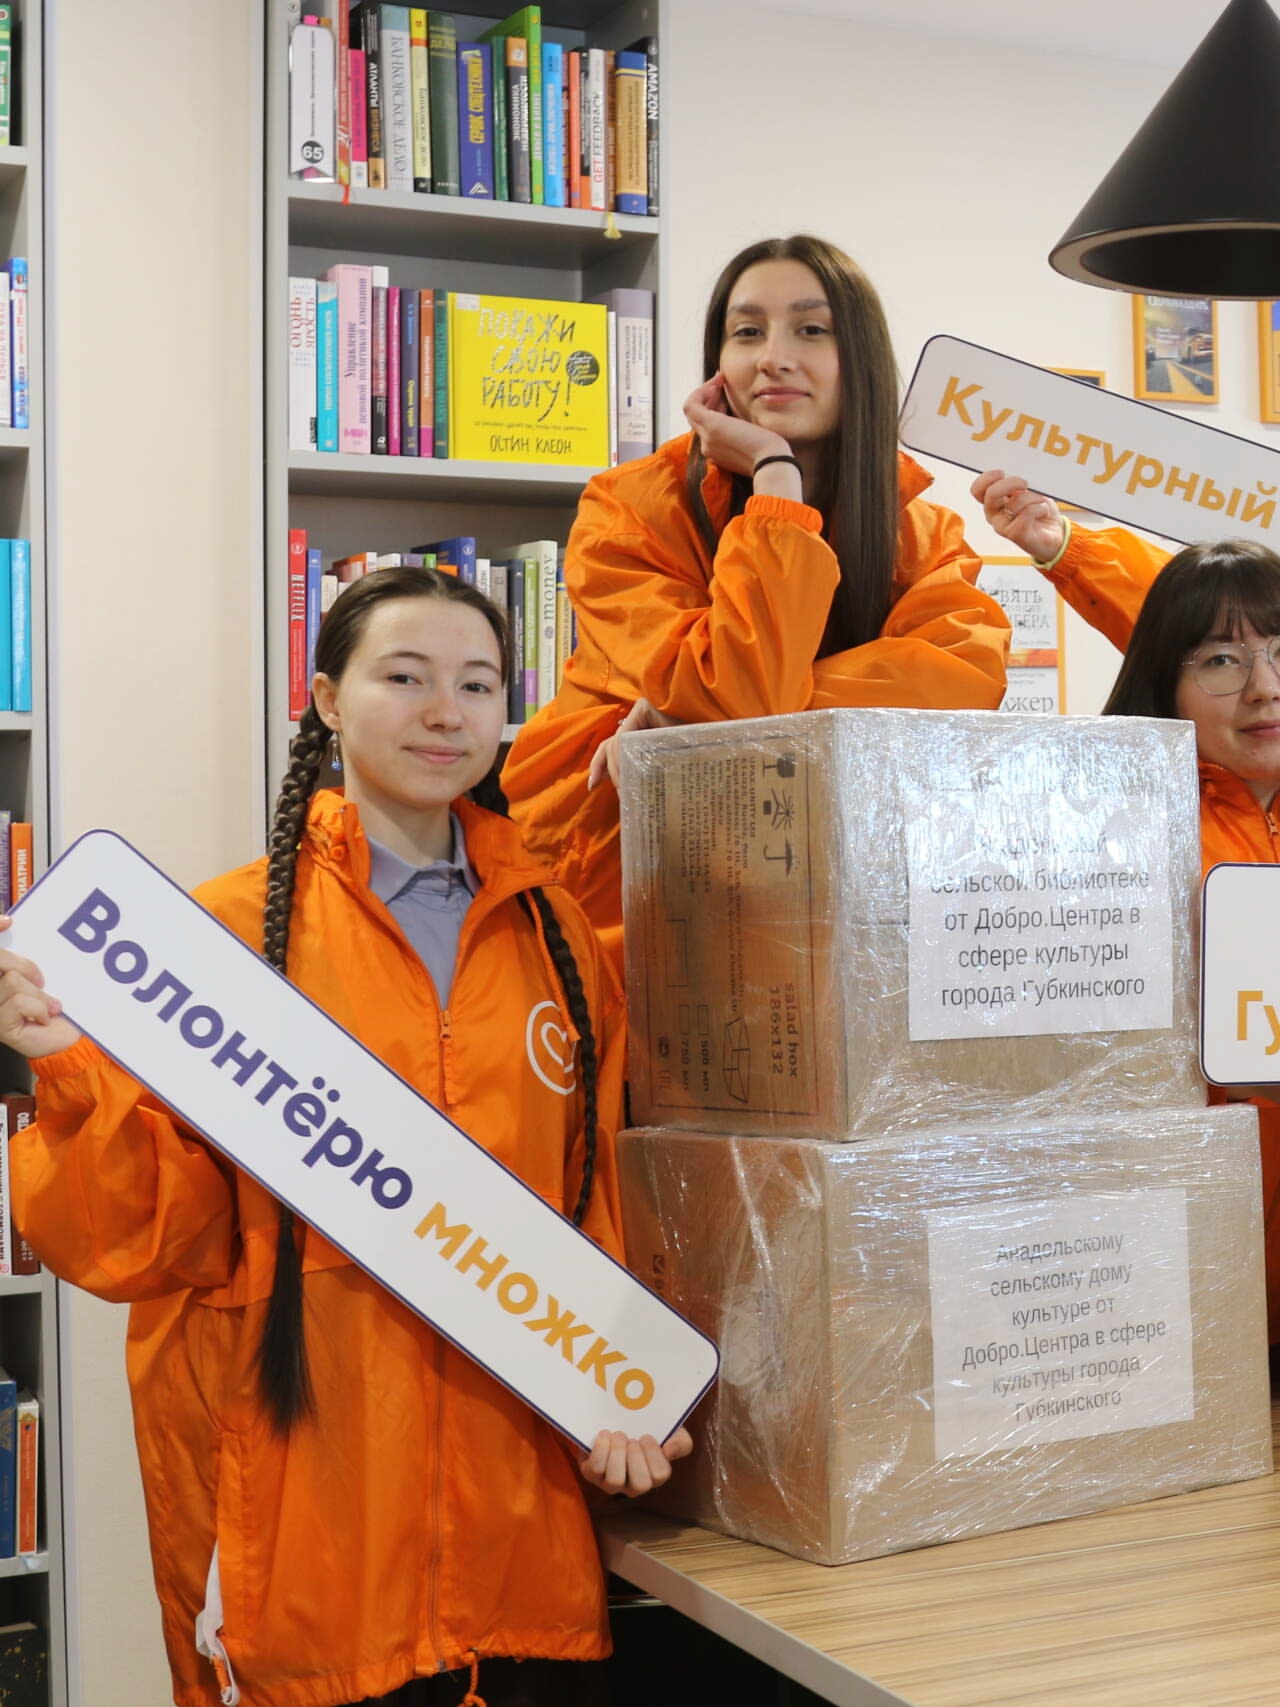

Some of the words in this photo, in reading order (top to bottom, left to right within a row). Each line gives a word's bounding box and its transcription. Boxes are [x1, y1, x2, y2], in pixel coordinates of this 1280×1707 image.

[369, 61, 380, 108] АТЛАНТЫ
[390, 36, 405, 131] БАНКОВСКОЕ
[647, 63, 658, 120] AMAZON
[511, 83, 522, 141] ЭКОНОМИКА
[592, 91, 604, 156] FEEDBACK
[303, 146, 323, 161] 65
[391, 133, 407, 173] ДЕЛО
[592, 158, 604, 183] GET
[478, 307, 576, 344] ПОКАЖИ
[491, 345, 561, 374] СВОЮ
[482, 376, 572, 422] РАБОТУ!
[490, 434, 530, 453] ОСТИН
[536, 437, 572, 454] КЛЕОН
[937, 375, 1277, 530] Культурный
[290, 574, 304, 621] NETFLIX
[543, 553, 556, 620] money
[944, 911, 968, 932] от
[974, 905, 1124, 935] Добро.Центра
[1129, 907, 1141, 923] в
[958, 944, 1028, 971] сфере
[1035, 943, 1129, 968] культуры
[785, 984, 799, 1035] salad
[941, 984, 1016, 1009] города
[1023, 977, 1146, 1006] Губкинского
[768, 985, 784, 1075] 186x132
[787, 1040, 799, 1077] box
[56, 887, 413, 1210] Волонтёрю
[412, 1201, 656, 1412] множко
[990, 1271, 1084, 1297] сельскому
[1088, 1263, 1133, 1289] дому
[1012, 1299, 1091, 1330] культуре
[1096, 1296, 1115, 1313] от
[962, 1331, 1090, 1371] Добро.Центра
[1096, 1330, 1106, 1345] в
[1110, 1320, 1167, 1347] сфере
[992, 1366, 1075, 1398] культуры
[1080, 1354, 1142, 1382] города
[1014, 1388, 1122, 1422] Губкинского
